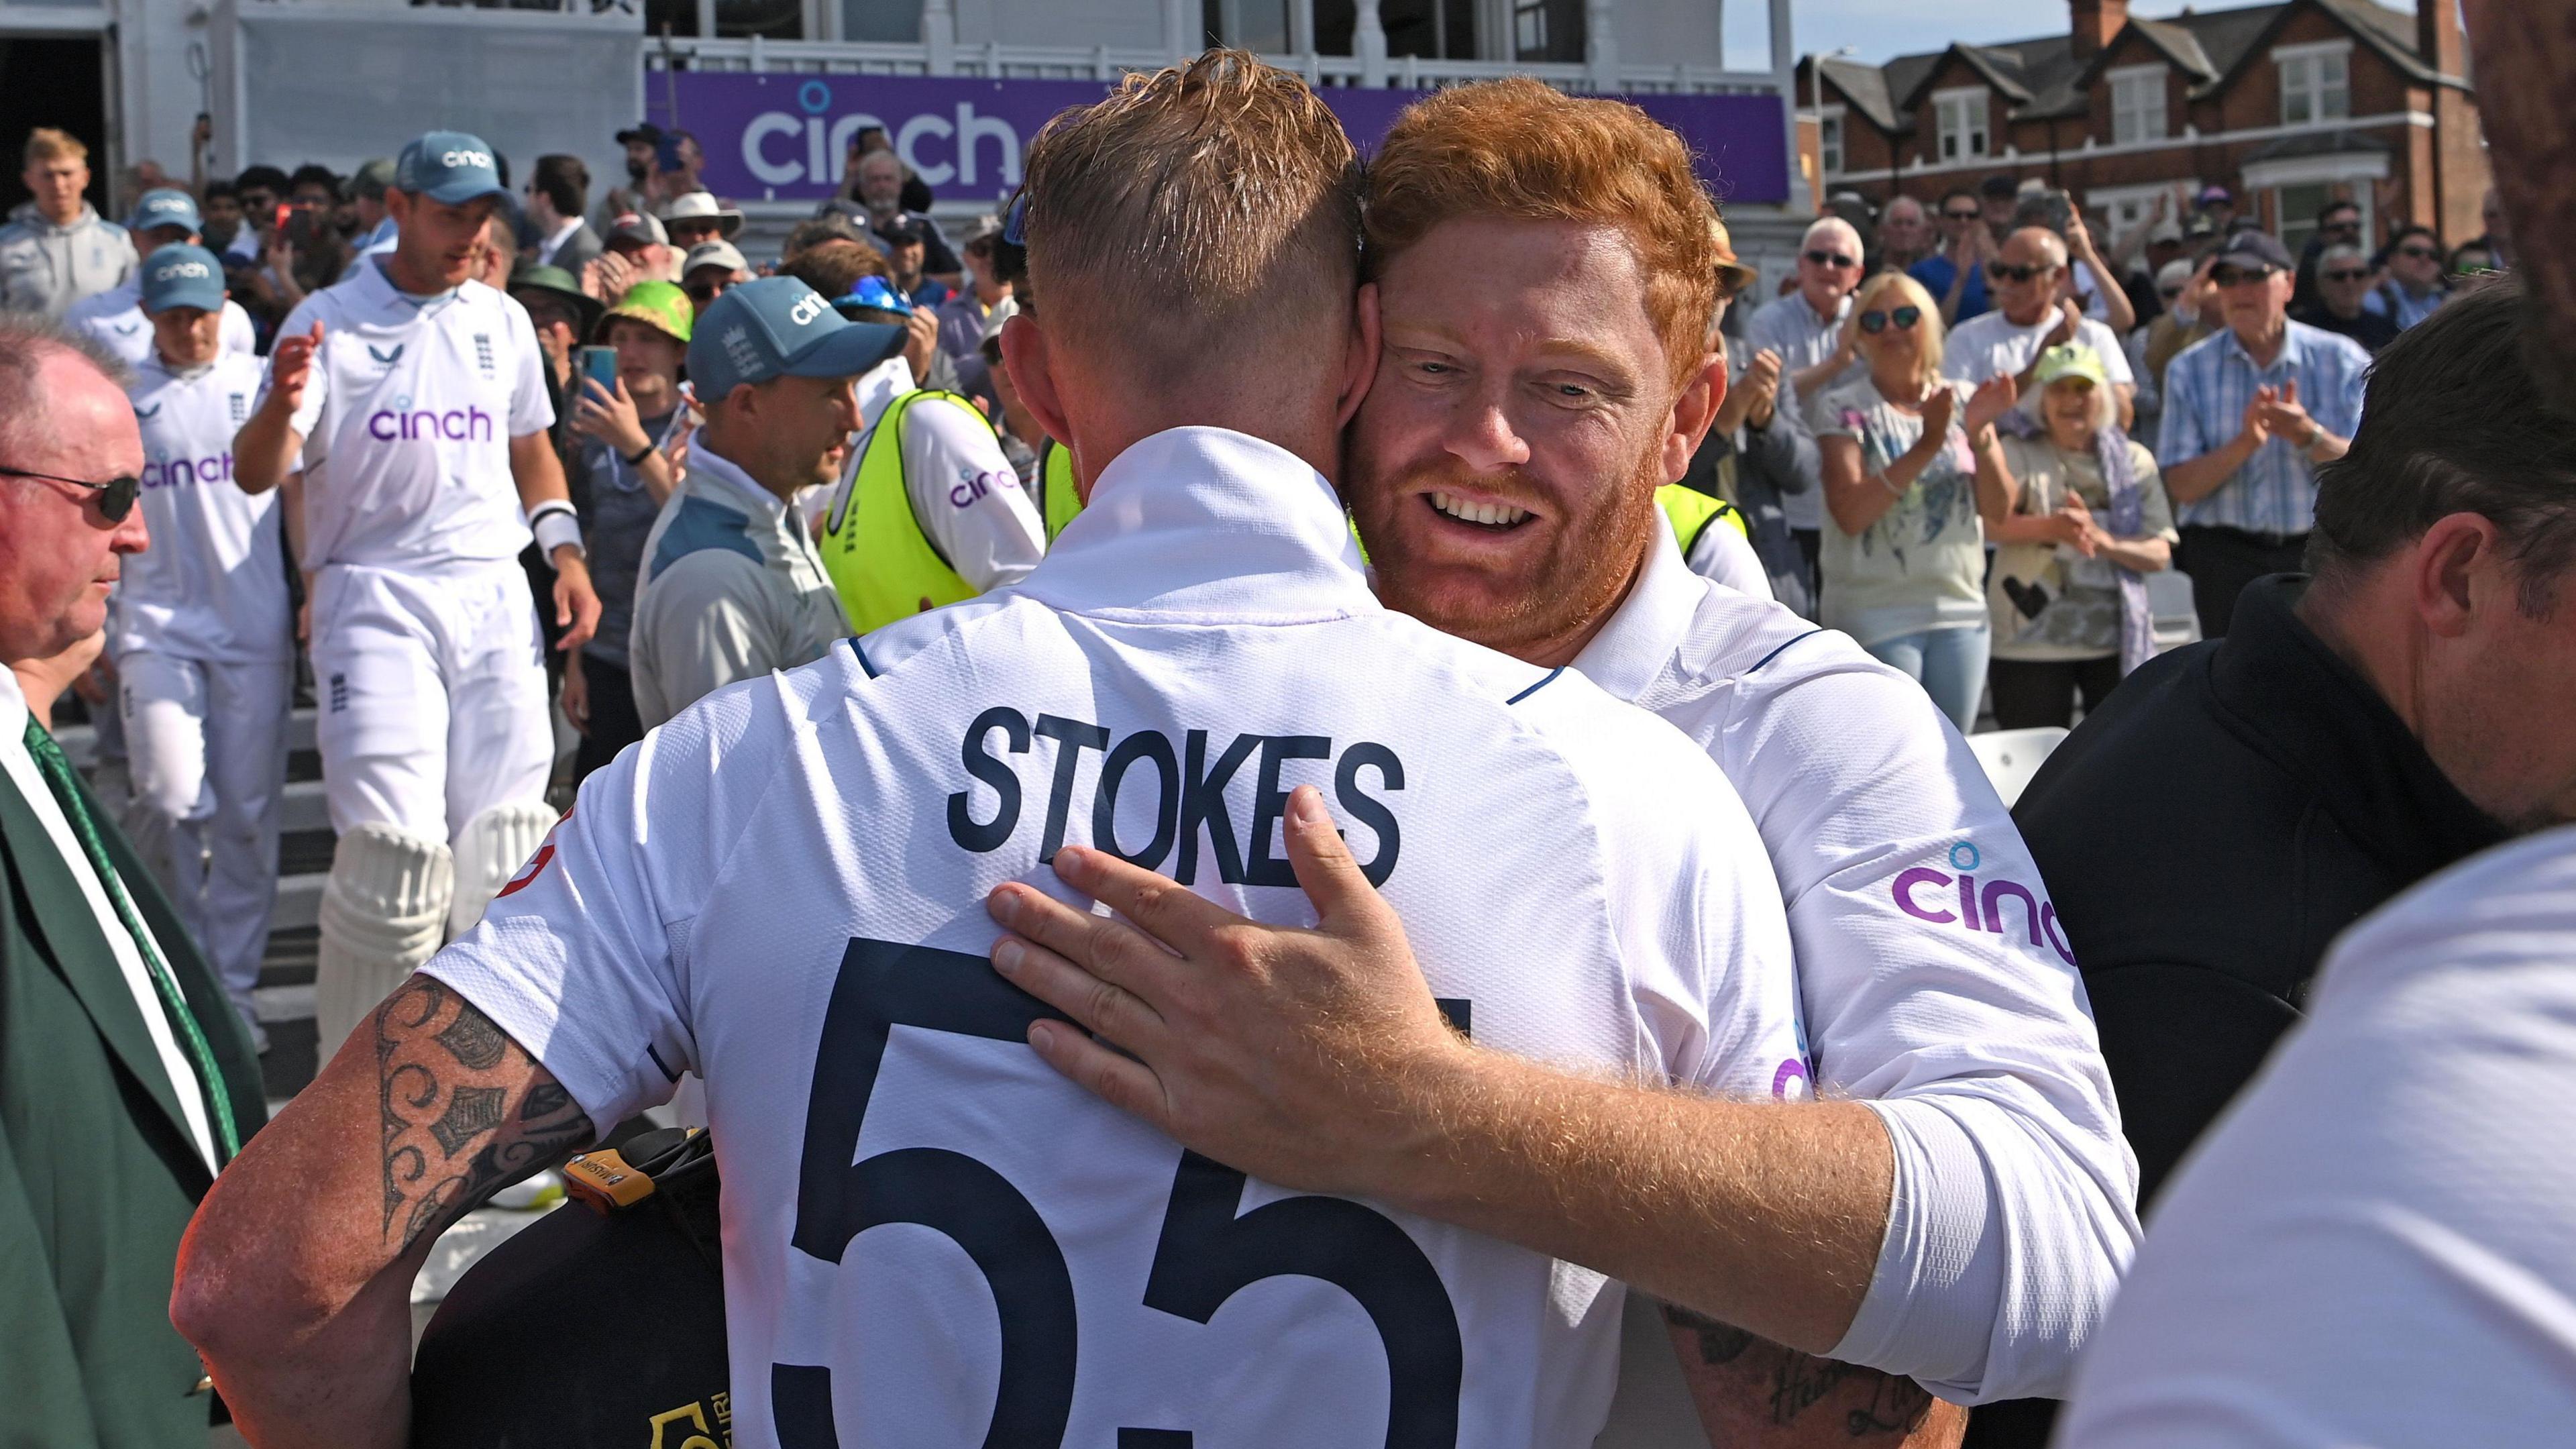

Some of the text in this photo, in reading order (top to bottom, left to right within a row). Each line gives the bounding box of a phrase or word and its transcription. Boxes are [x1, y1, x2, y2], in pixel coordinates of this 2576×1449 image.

[741, 79, 1021, 185] cinch
[370, 395, 491, 442] cinch
[947, 706, 1405, 889] STOKES
[771, 936, 1471, 1449] 55
